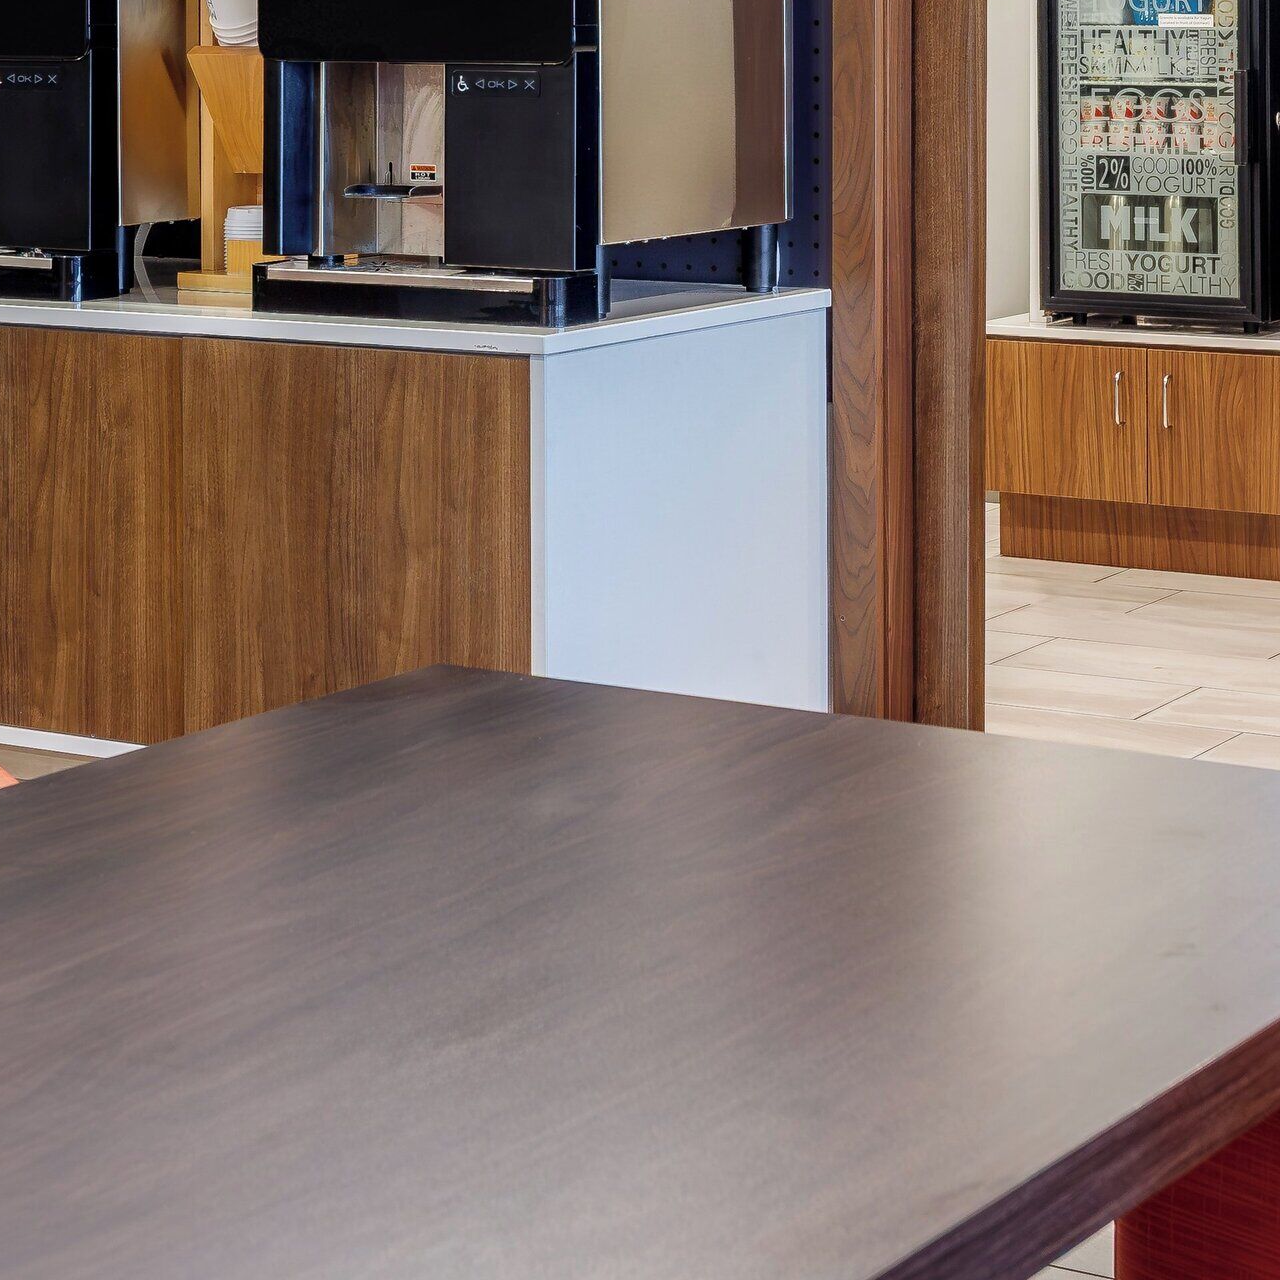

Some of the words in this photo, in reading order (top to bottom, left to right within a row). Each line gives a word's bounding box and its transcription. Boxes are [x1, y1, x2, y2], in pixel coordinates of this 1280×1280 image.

[1080, 29, 1185, 55] HEALTHY
[1199, 29, 1217, 76] FRESH
[487, 80, 505, 88] OK
[1061, 34, 1078, 105] FRESH
[1091, 87, 1207, 123] EGGS
[1062, 108, 1078, 166] EGGS
[1080, 135, 1147, 154] FRESH
[1218, 100, 1235, 185] YOGURT
[1081, 154, 1095, 192] 100%
[1098, 157, 1129, 189] 2%
[1132, 156, 1179, 175] GOOD
[1181, 158, 1218, 176] 100%
[1133, 175, 1216, 194] YOGURT
[1062, 168, 1078, 251] HEALTHY
[1100, 205, 1198, 243] MILK
[1065, 251, 1124, 271] FRESH
[1125, 253, 1221, 275] YOGURT
[1062, 270, 1125, 290] GOOD
[1128, 274, 1144, 292] 2%
[1146, 274, 1237, 296] HEALTHY
